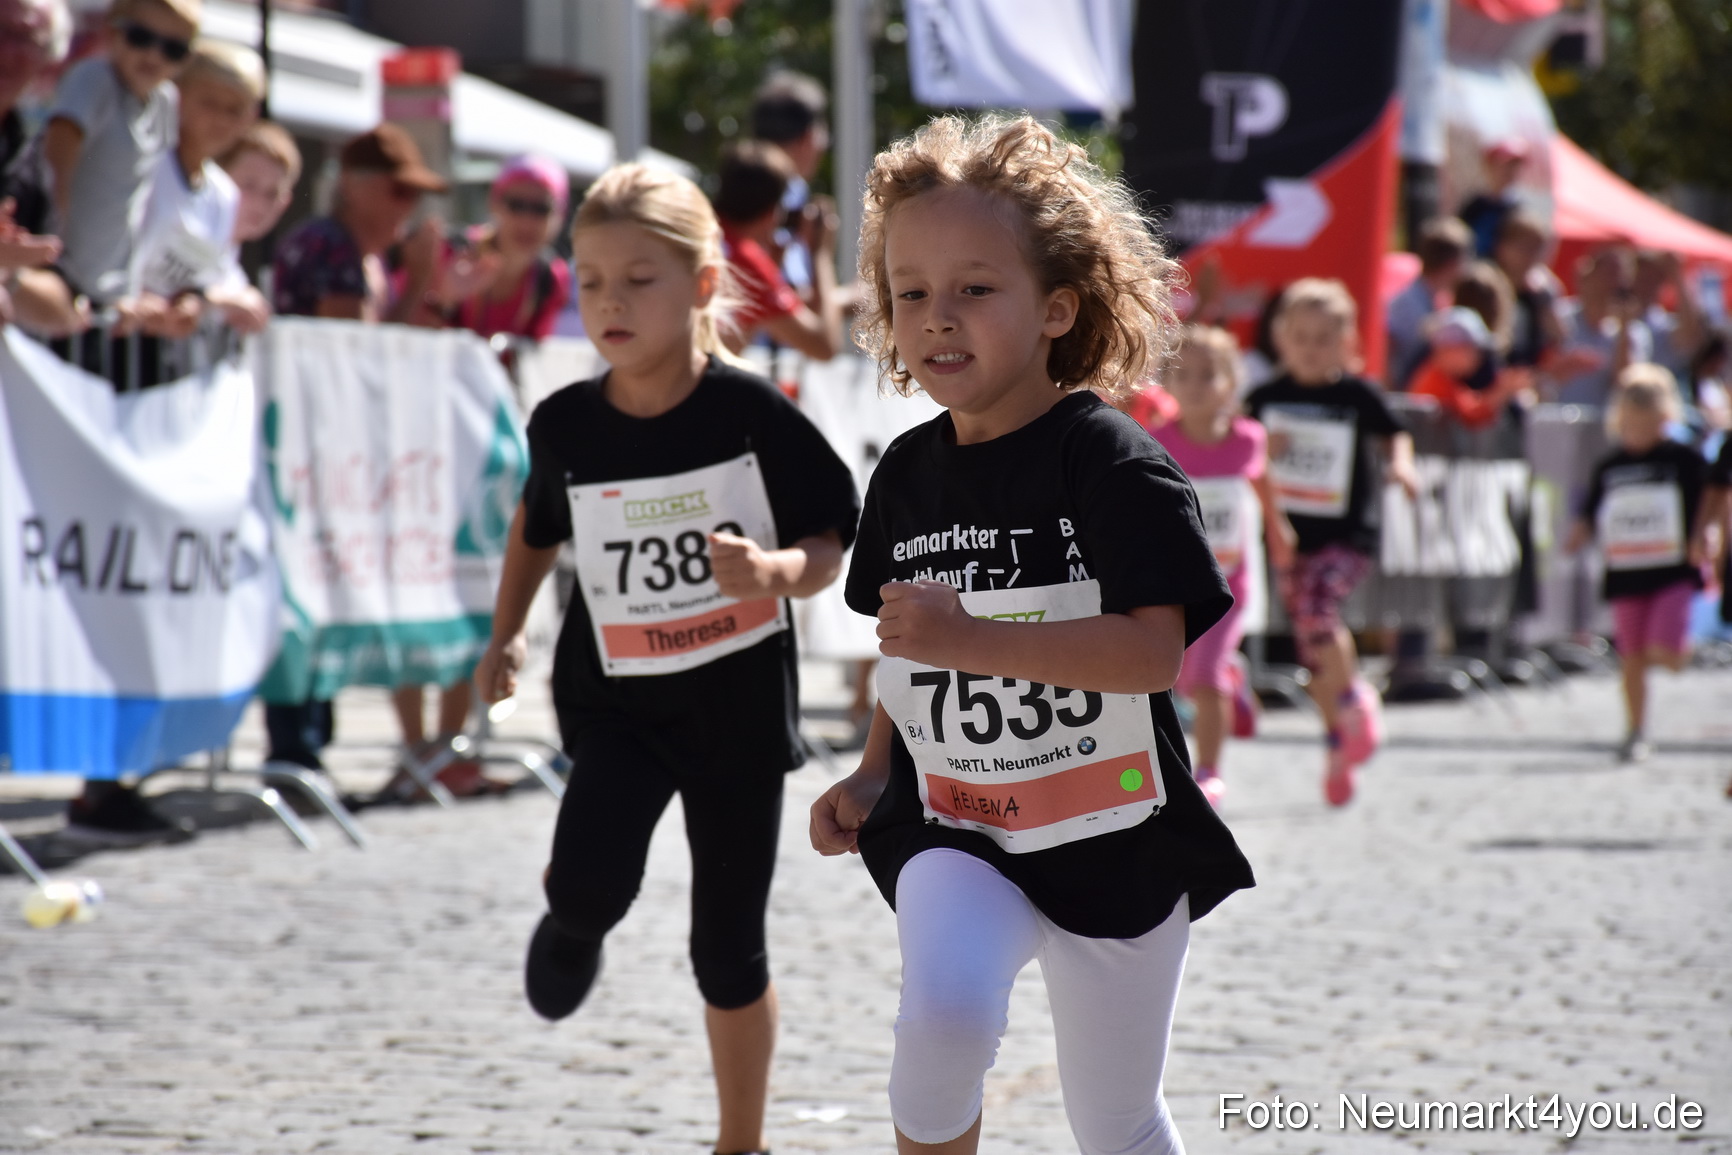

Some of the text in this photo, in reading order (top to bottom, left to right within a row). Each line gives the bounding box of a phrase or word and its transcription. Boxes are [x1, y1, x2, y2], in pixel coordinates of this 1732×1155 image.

[624, 489, 711, 522] BOCK
[643, 614, 738, 653] Theresa
[910, 670, 1104, 745] 7535
[947, 745, 1073, 773] PARTL Neumarkt
[949, 784, 1020, 819] HELENA
